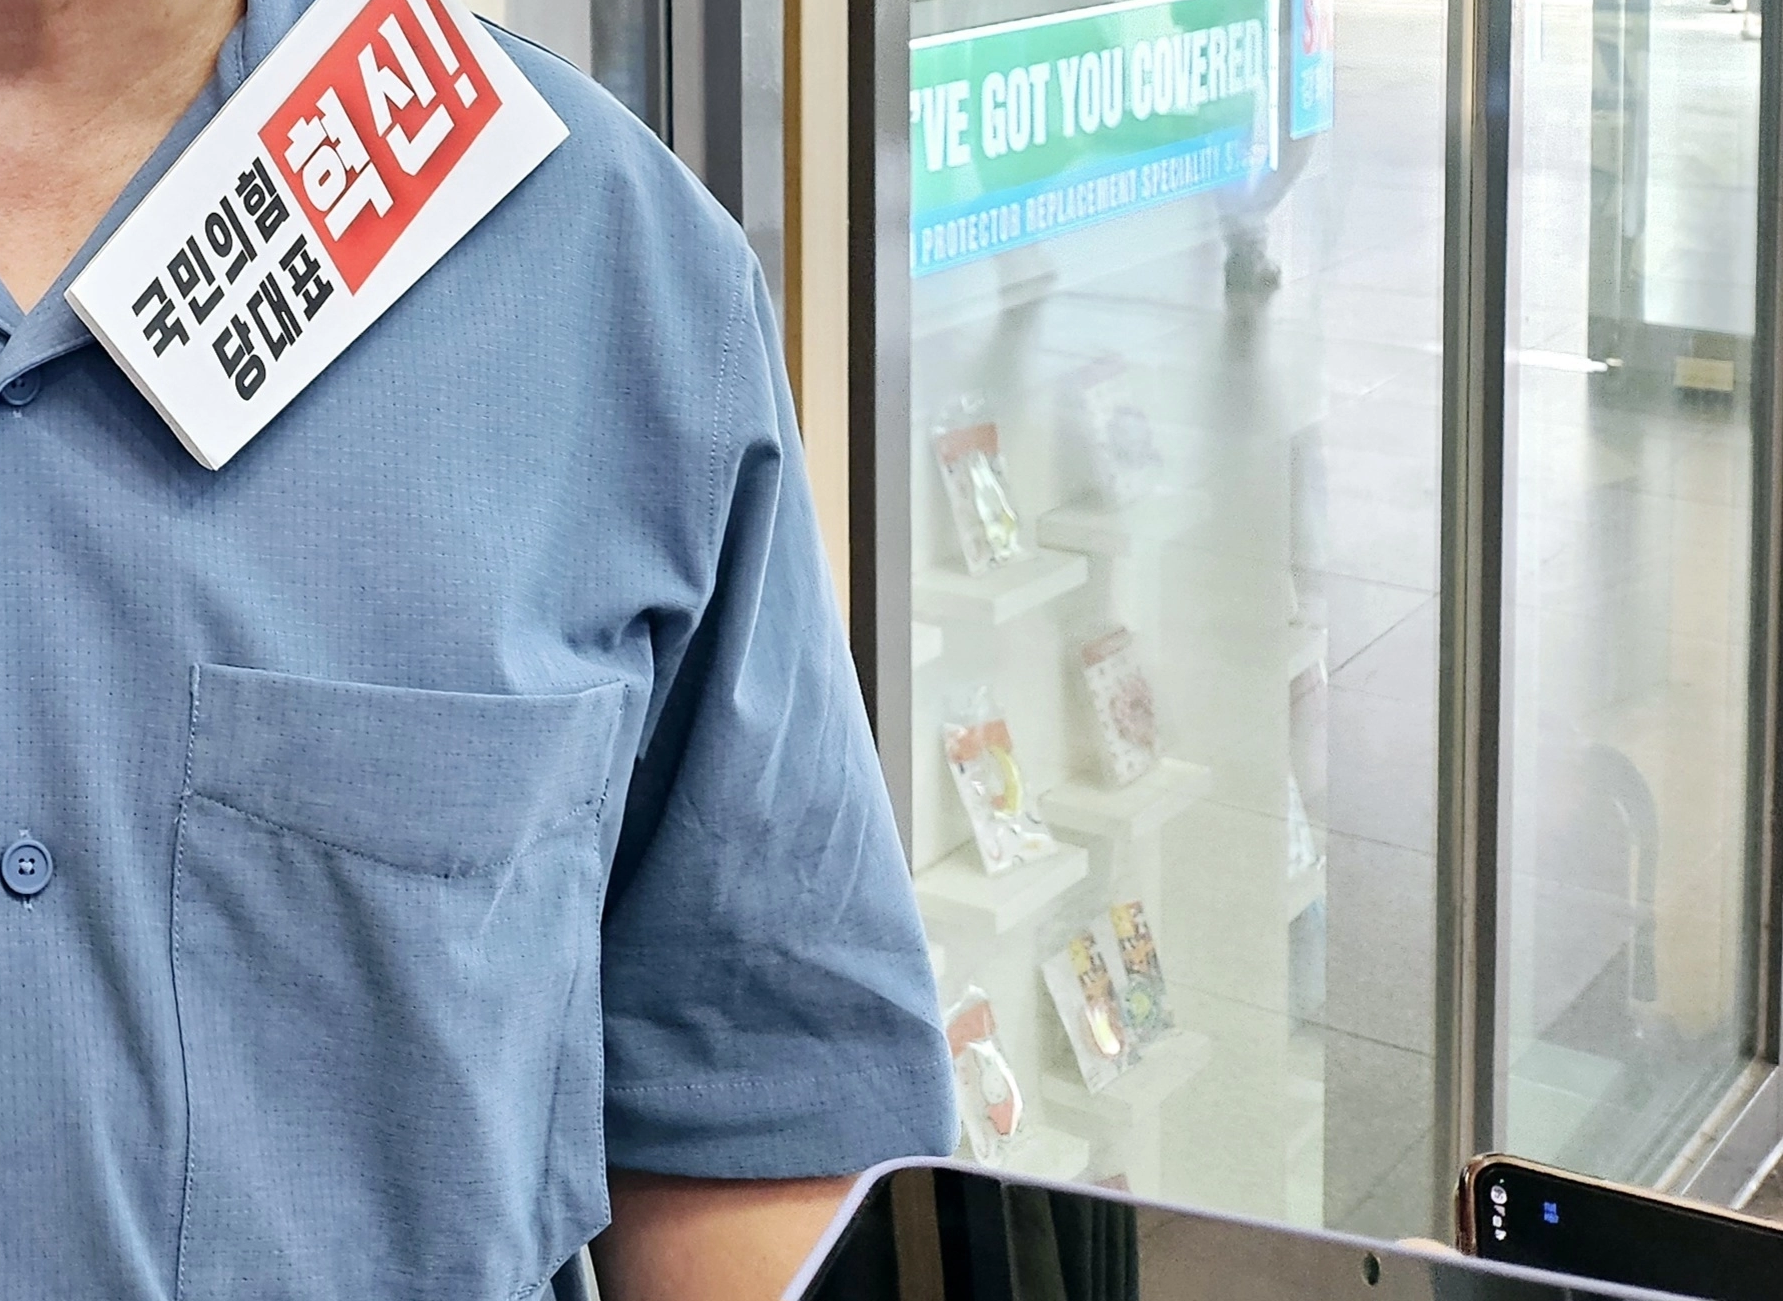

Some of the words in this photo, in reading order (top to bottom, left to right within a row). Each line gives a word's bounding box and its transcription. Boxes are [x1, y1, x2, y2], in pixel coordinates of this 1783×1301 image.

[981, 62, 1051, 160] GOT
[1057, 46, 1124, 140] YOU
[1130, 17, 1264, 121] COVERED
[131, 156, 291, 358] 국민의힘
[921, 201, 1020, 266] PROTECTOR
[1026, 169, 1138, 234] REPLACEMENT
[211, 234, 335, 402] 당대표
